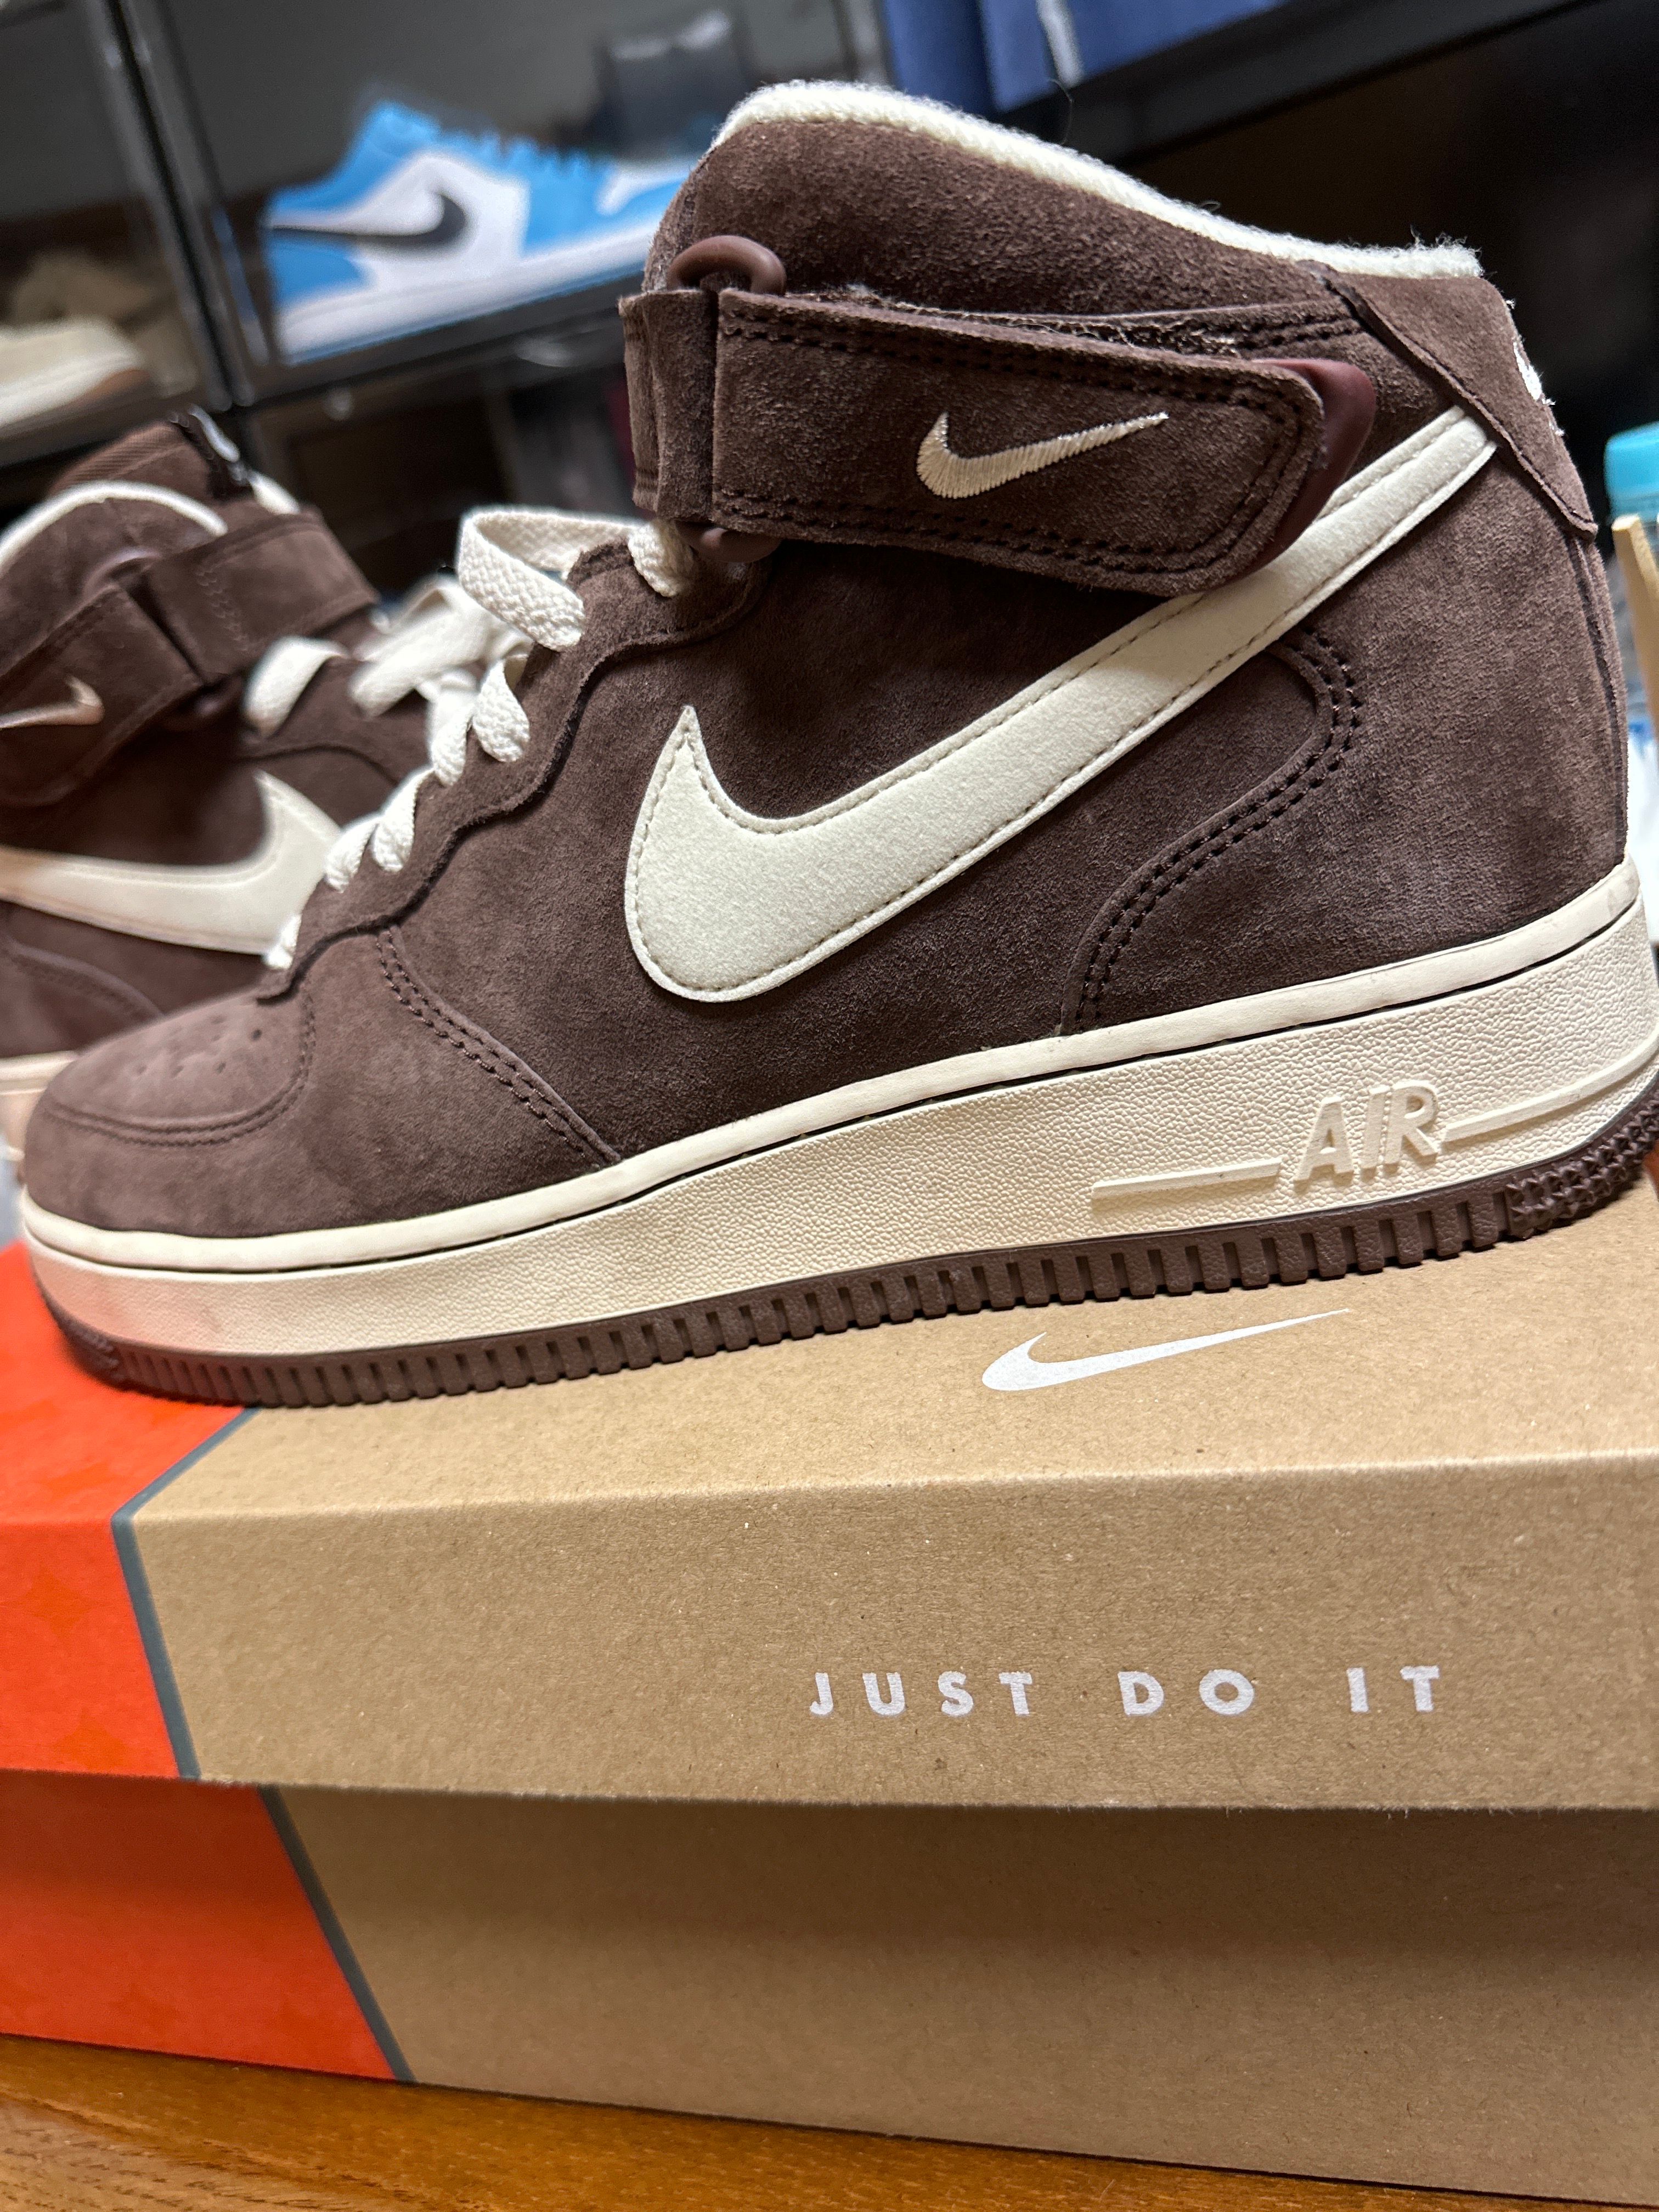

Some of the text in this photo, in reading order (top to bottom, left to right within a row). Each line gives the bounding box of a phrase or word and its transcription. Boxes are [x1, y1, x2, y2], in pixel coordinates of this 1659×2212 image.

[1293, 1080, 1440, 1186] AIR
[809, 1664, 1441, 1718] JUST DO IT
